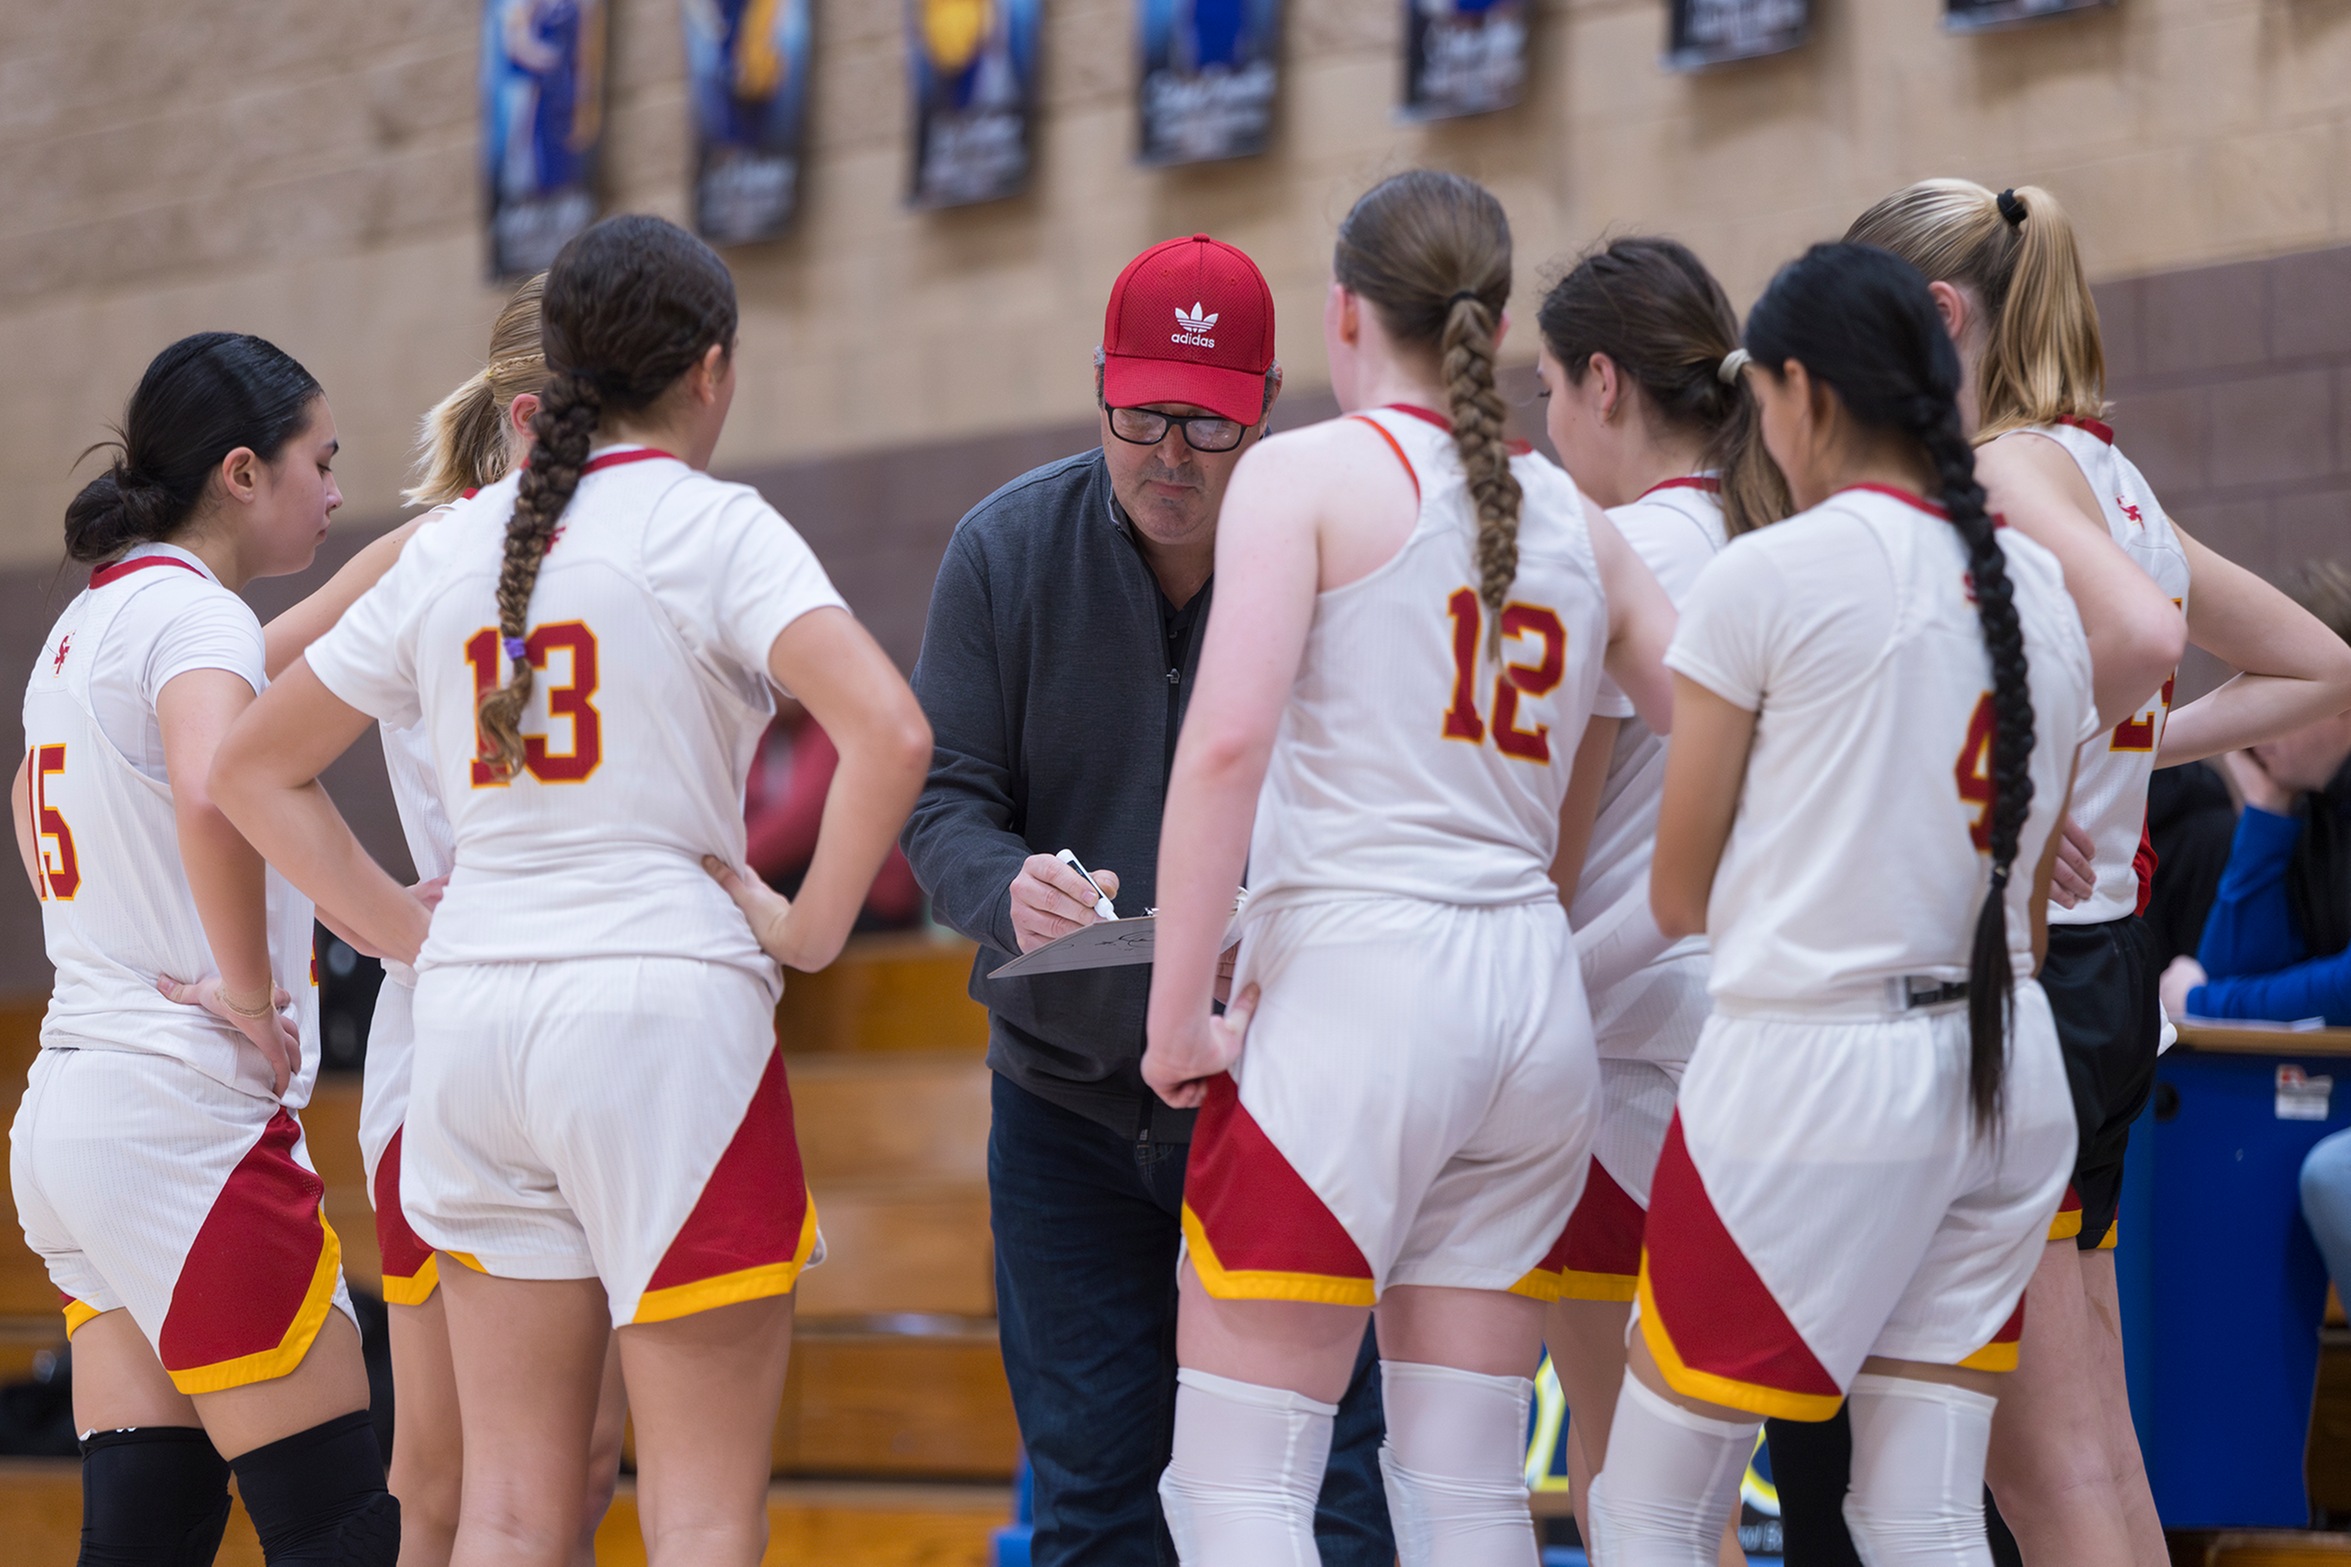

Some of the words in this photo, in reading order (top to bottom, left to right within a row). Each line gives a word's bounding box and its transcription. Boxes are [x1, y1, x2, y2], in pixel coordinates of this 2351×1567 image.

[1171, 332, 1215, 349] adidas
[464, 619, 603, 789] 13
[1441, 585, 1567, 767] 12
[27, 743, 82, 901] 15
